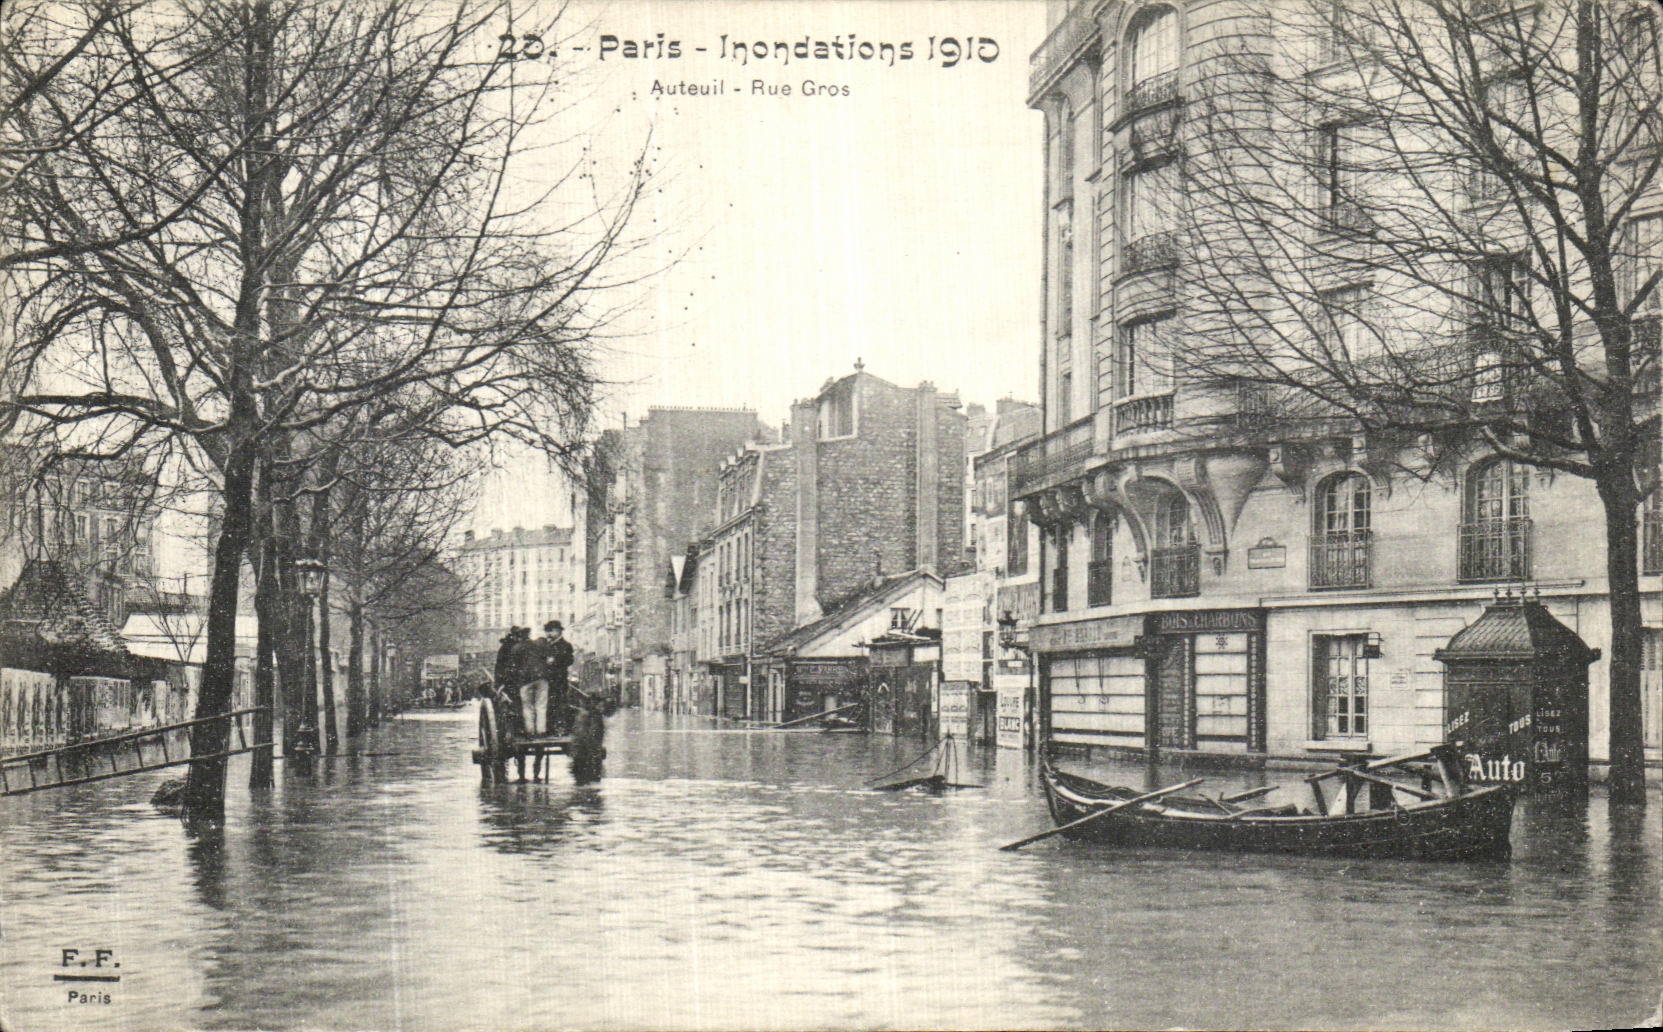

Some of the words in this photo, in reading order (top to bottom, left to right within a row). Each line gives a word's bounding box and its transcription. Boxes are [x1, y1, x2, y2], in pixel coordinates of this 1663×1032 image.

[1447, 711, 1470, 734] LISEZ
[1508, 714, 1532, 735] TOUS
[1464, 753, 1526, 781] Auto
[1540, 772, 1553, 784] 5
